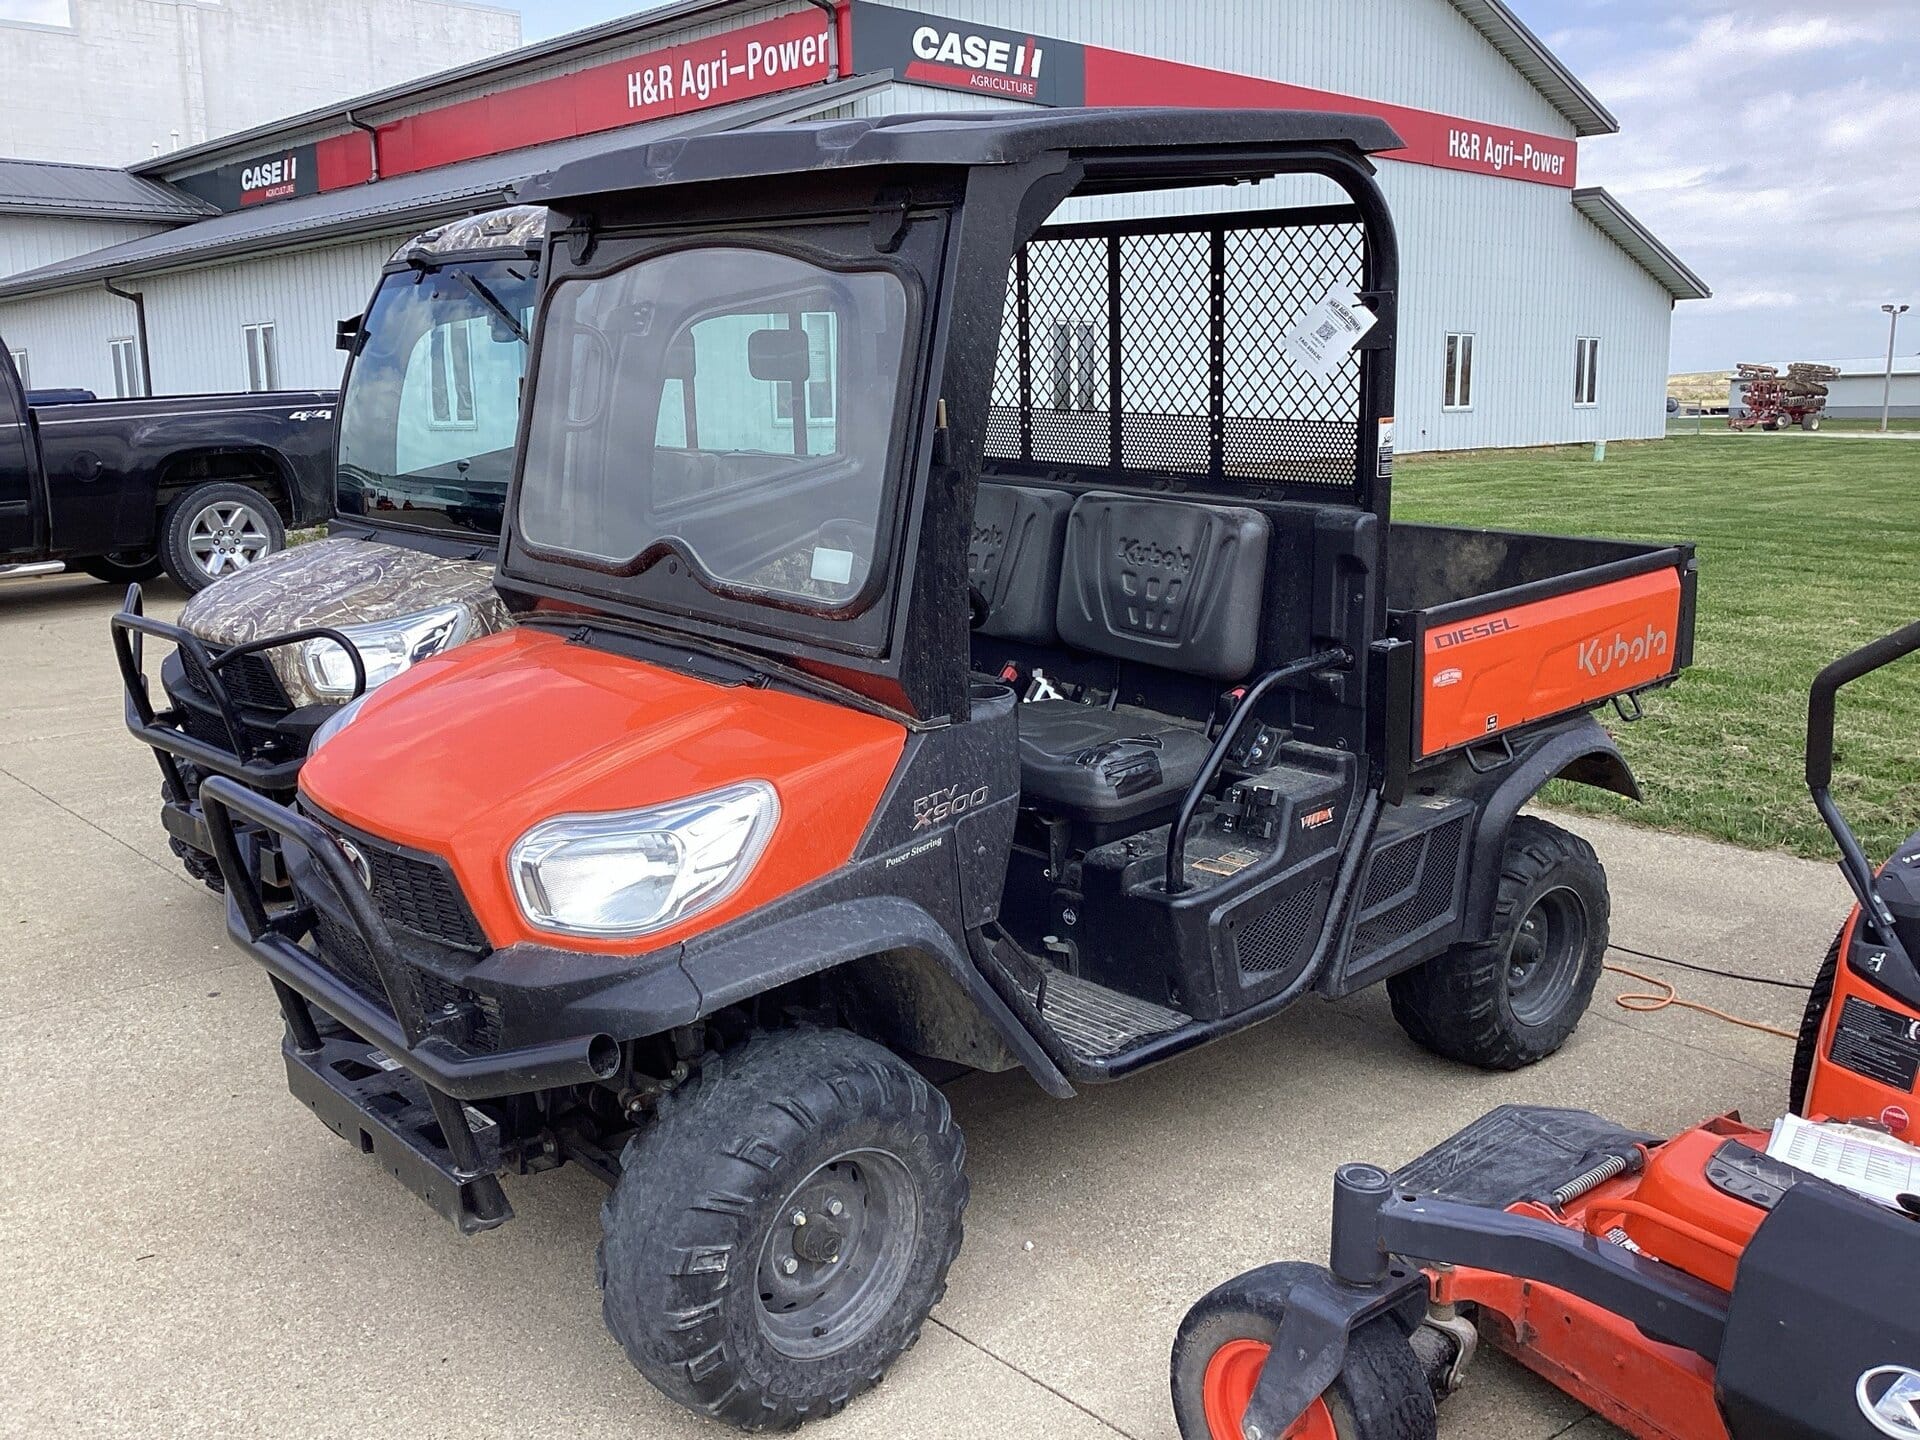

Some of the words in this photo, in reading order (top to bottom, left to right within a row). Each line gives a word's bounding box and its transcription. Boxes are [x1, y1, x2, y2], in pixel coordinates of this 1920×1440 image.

[912, 26, 1010, 73] CASE
[627, 64, 674, 108] H&R
[680, 32, 829, 101] Agri-Power
[970, 74, 1034, 95] AGRICULTURE
[1449, 129, 1480, 161] H&R
[1484, 136, 1565, 176] Agri-Power
[241, 160, 281, 191] CASE
[1118, 537, 1193, 574] Kubota
[1434, 617, 1519, 650] DIESEL
[1577, 623, 1667, 677] Kubota
[912, 785, 989, 832] X900
[913, 783, 959, 814] RTV
[885, 851, 911, 868] Power
[911, 837, 942, 857] Steering
